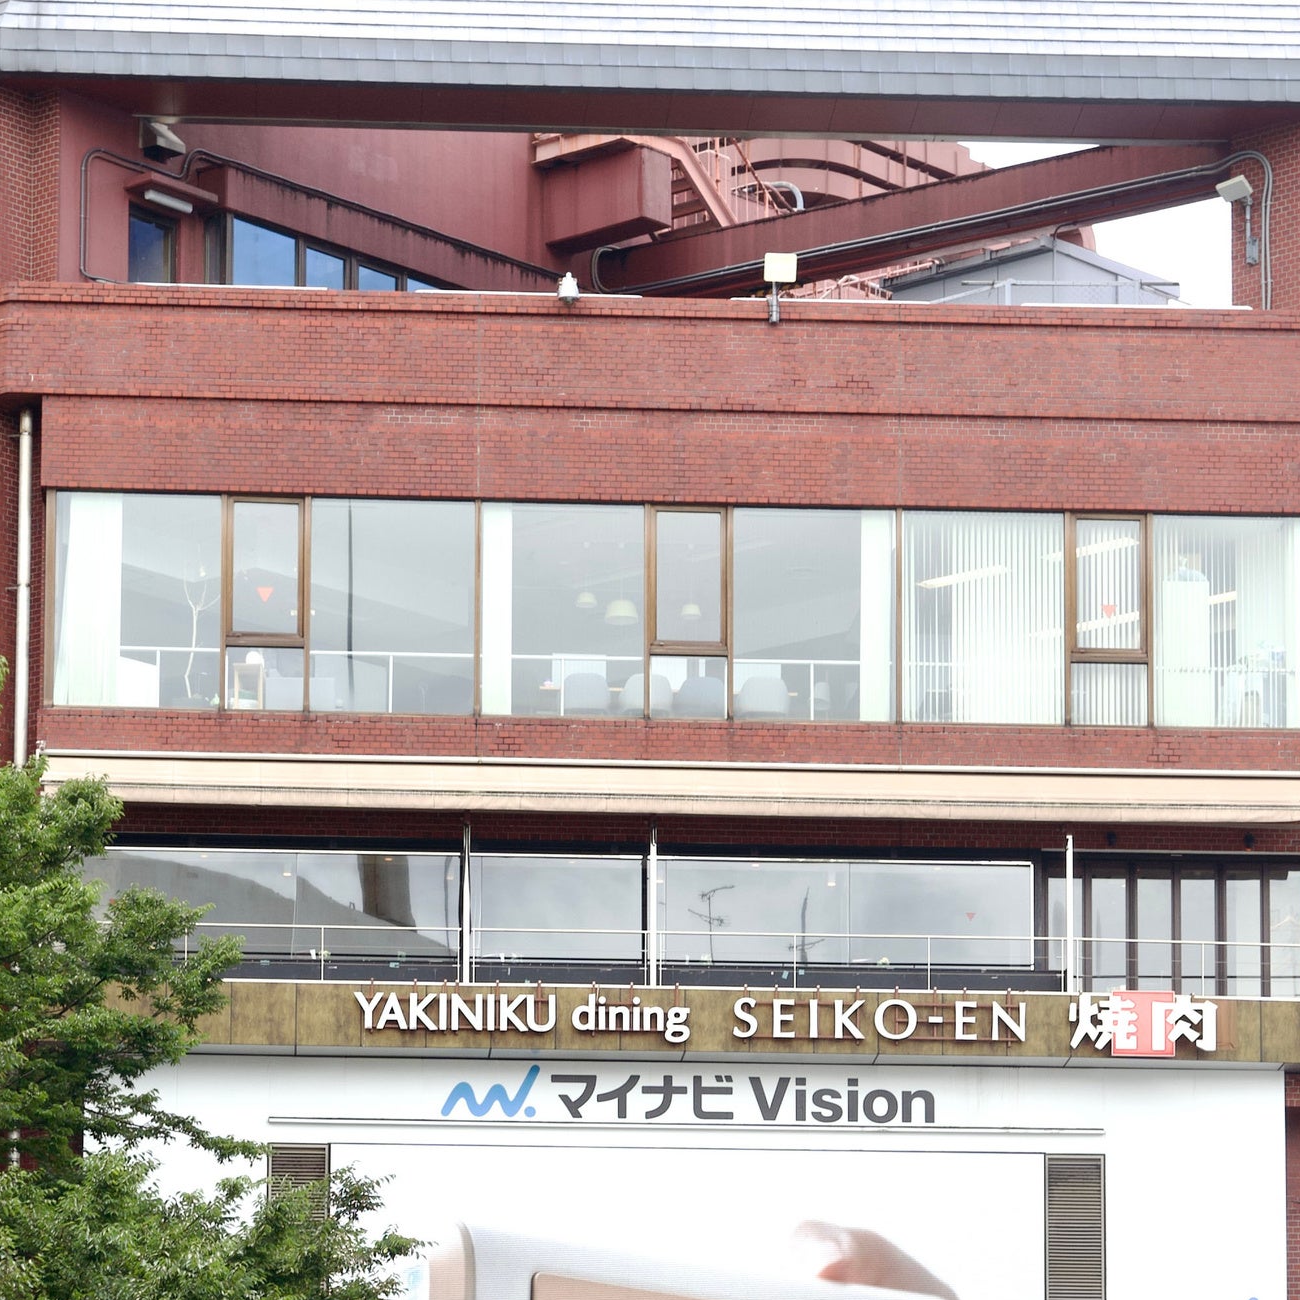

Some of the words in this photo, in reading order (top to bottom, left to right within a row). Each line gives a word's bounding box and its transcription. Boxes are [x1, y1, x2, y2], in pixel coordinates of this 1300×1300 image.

[354, 991, 557, 1034] YAKINIKU
[571, 996, 692, 1043] dining
[733, 996, 1027, 1043] SEIKO-EN
[1069, 994, 1218, 1053] 焼肉
[550, 1074, 734, 1120] マイナビ
[748, 1076, 936, 1124] Vision
